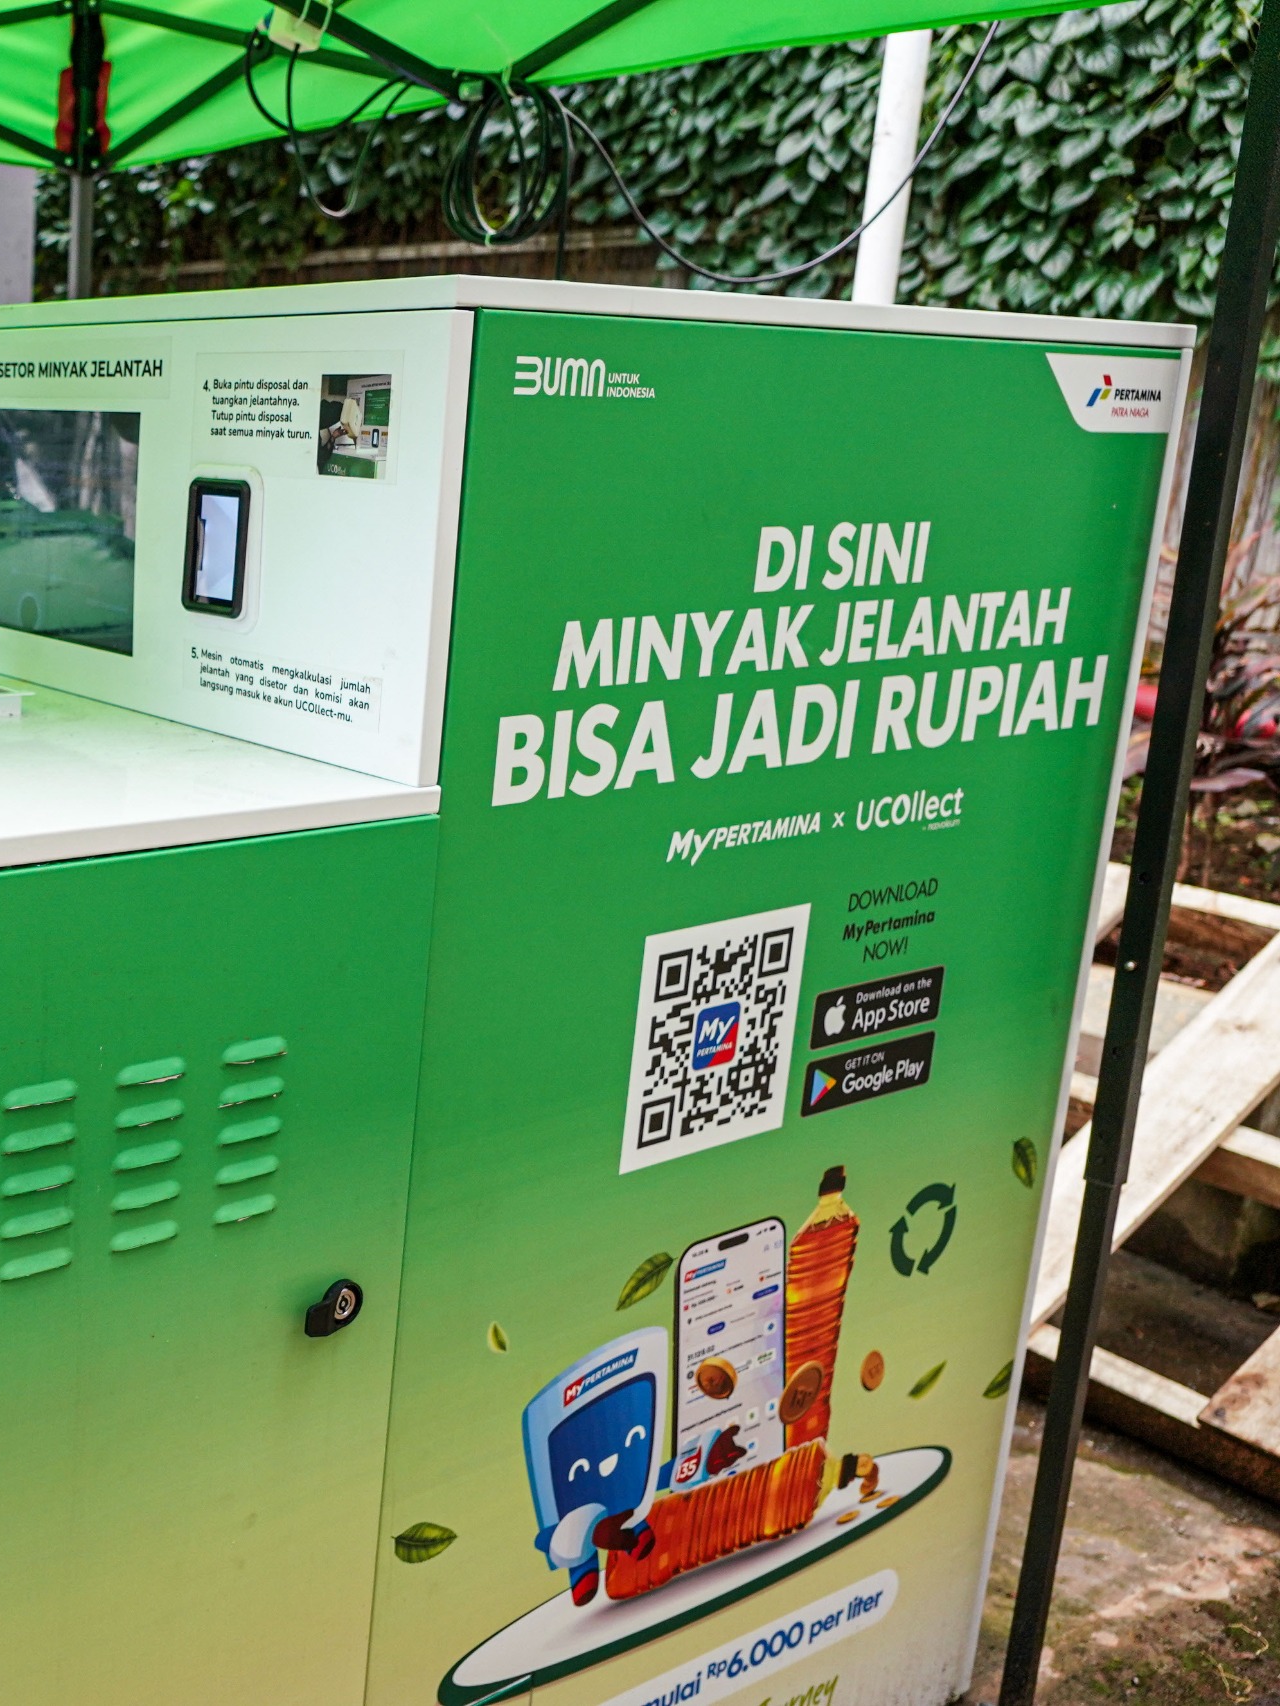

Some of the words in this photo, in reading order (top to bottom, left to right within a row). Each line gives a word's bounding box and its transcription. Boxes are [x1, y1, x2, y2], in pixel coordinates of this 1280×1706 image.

[38, 361, 88, 378] MINYAK
[90, 359, 163, 378] JELANTAH
[608, 372, 641, 385] UNTUK
[202, 380, 211, 392] 4.
[213, 379, 232, 390] Buka
[234, 379, 254, 392] pintu
[256, 379, 290, 393] disposal
[292, 379, 309, 390] dan
[606, 386, 656, 399] INDONESIA
[1114, 388, 1162, 402] PERTAMINA
[212, 395, 248, 408] tuangkan
[249, 395, 300, 408] jelantahnya.
[1111, 407, 1128, 417] PATRA
[1130, 407, 1149, 417] NIAGA
[211, 410, 233, 423] Tutup
[235, 410, 256, 424] pintu
[258, 411, 292, 425] disposal
[210, 425, 226, 436] saat
[228, 428, 254, 437] semua
[256, 426, 285, 440] minyak
[287, 429, 312, 439] turun.
[753, 525, 814, 593] DI
[821, 521, 931, 589] SINI
[552, 604, 815, 692] MINYAK
[819, 587, 1072, 666] JELANTAH
[191, 647, 199, 660] 5.
[201, 649, 223, 662] Mesin
[230, 656, 264, 671] otomatis
[272, 665, 332, 686] mengkalkulasi
[340, 678, 371, 695] jumlah
[199, 663, 230, 678] jelantah
[235, 673, 254, 686] yang
[259, 677, 287, 691] disetor
[293, 683, 309, 696] dan
[314, 688, 342, 704] komisi
[348, 697, 370, 711] akan
[199, 678, 233, 696] langsung
[235, 685, 260, 700] masuk
[262, 692, 272, 703] ke
[274, 695, 293, 708] akun
[491, 700, 675, 807] BISA
[690, 679, 861, 779] JADI
[871, 654, 1109, 755] RUPIAH
[666, 811, 821, 867] MyPERTAMINA
[856, 787, 964, 831] UCOllect
[848, 877, 938, 913] DOWNLOAD
[842, 909, 935, 942] MyPertamina
[862, 937, 909, 963] NOW!
[855, 981, 901, 1005] Download
[903, 981, 915, 994] on
[916, 977, 933, 991] the
[851, 1006, 886, 1032] App
[888, 996, 930, 1021] Store
[698, 1016, 735, 1044] My
[696, 1041, 733, 1058] PERTAMINA
[845, 1056, 861, 1071] GET
[862, 1054, 870, 1067] IT
[870, 1051, 885, 1064] ON
[842, 1064, 893, 1095] Google
[895, 1059, 924, 1081] Play
[808, 1609, 844, 1644] per
[846, 1590, 884, 1622] liter
